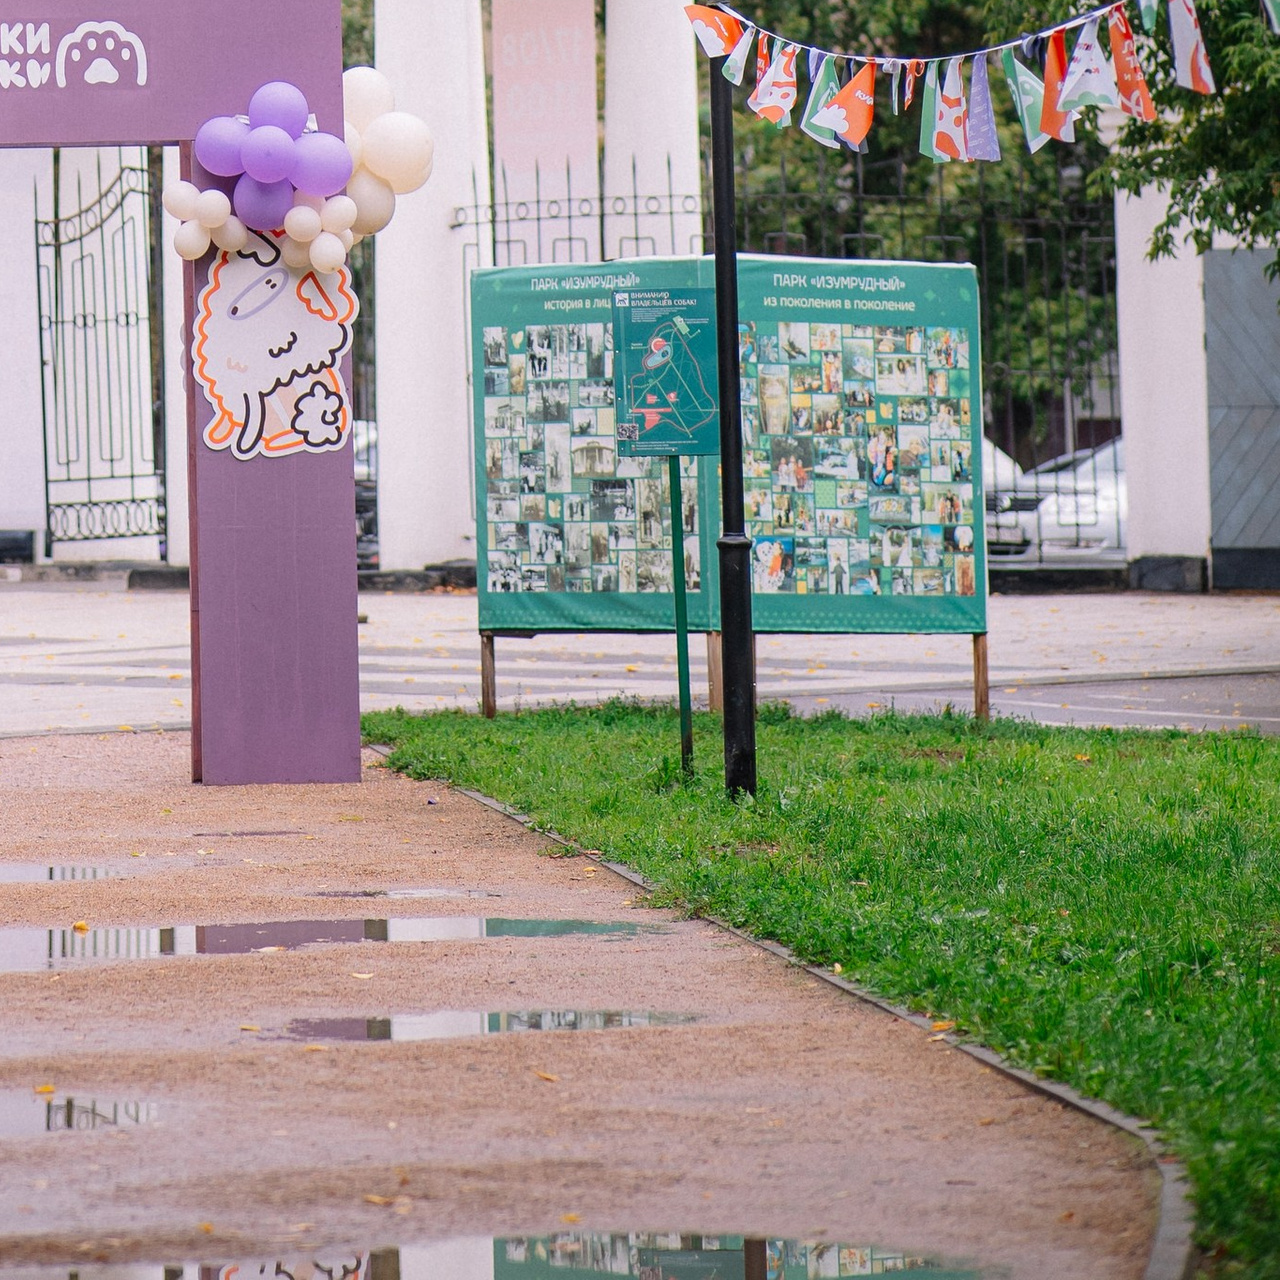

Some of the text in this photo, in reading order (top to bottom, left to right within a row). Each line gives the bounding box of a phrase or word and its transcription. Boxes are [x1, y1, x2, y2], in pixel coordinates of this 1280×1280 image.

[531, 271, 640, 291] ПАРК «ИЗУМРУДНЫЙ»
[773, 273, 906, 292] ПАРК «ИЗУМРУДНЫЙ»
[631, 291, 669, 299] ВНИМАНИЮ
[544, 298, 612, 313] история в лиц
[631, 299, 672, 308] ВЛАДЕЛЬЦЕВ
[763, 296, 915, 311] из поколения в поколение
